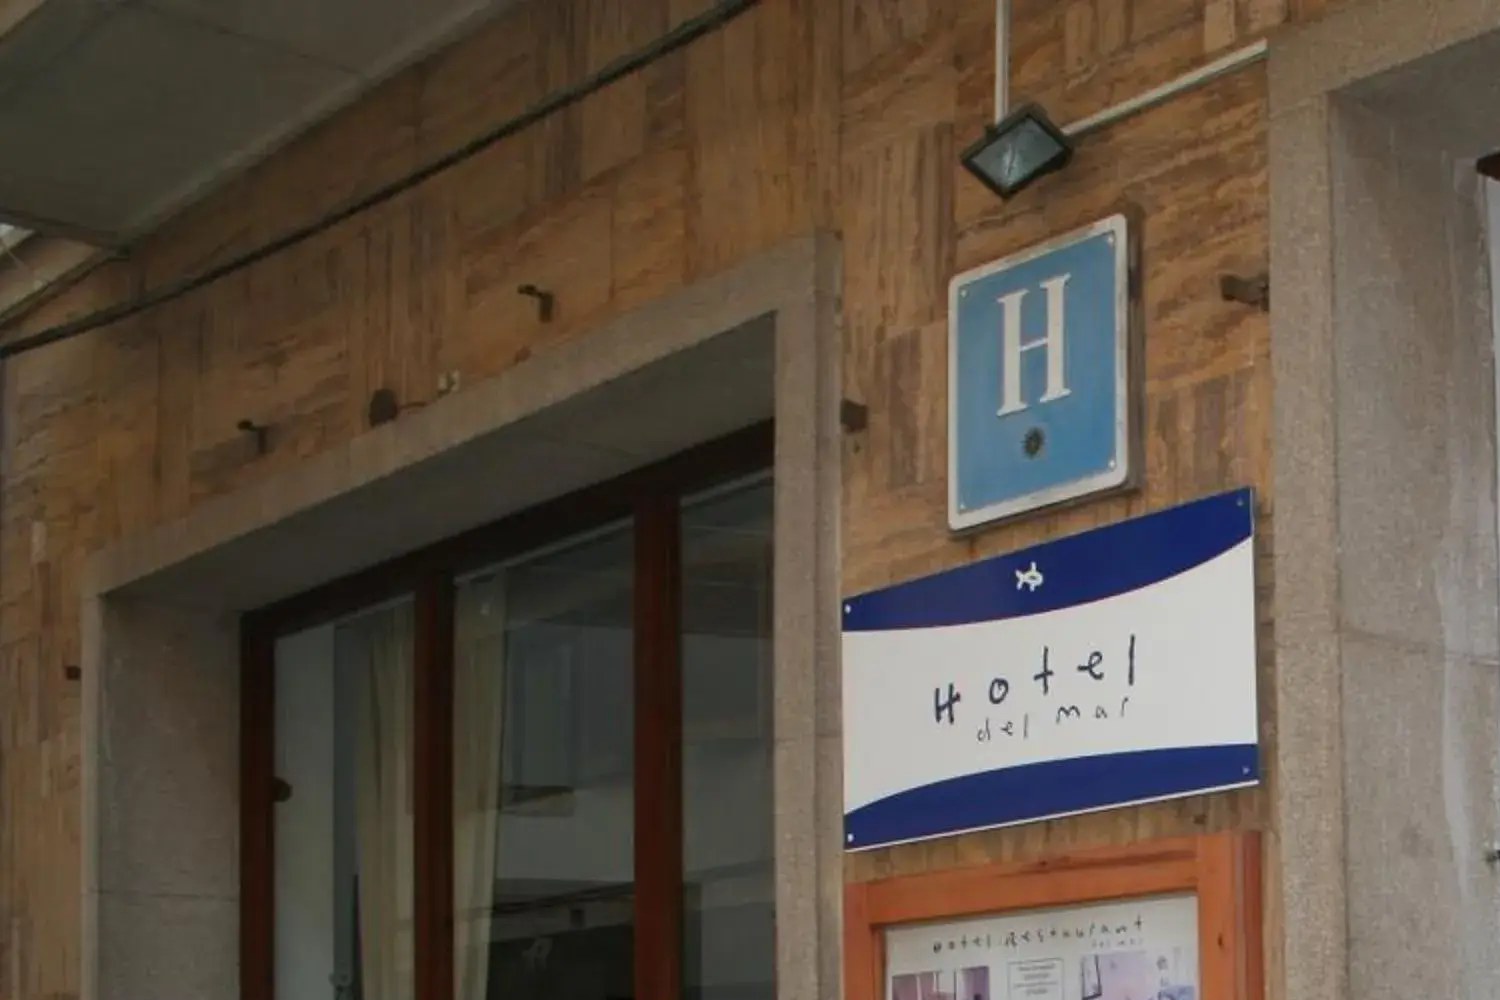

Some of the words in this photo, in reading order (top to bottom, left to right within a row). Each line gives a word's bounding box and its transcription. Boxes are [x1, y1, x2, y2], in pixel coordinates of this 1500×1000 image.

[996, 272, 1073, 418] H
[933, 634, 1138, 725] Hotel
[976, 714, 1029, 744] del
[1056, 696, 1130, 724] mar
